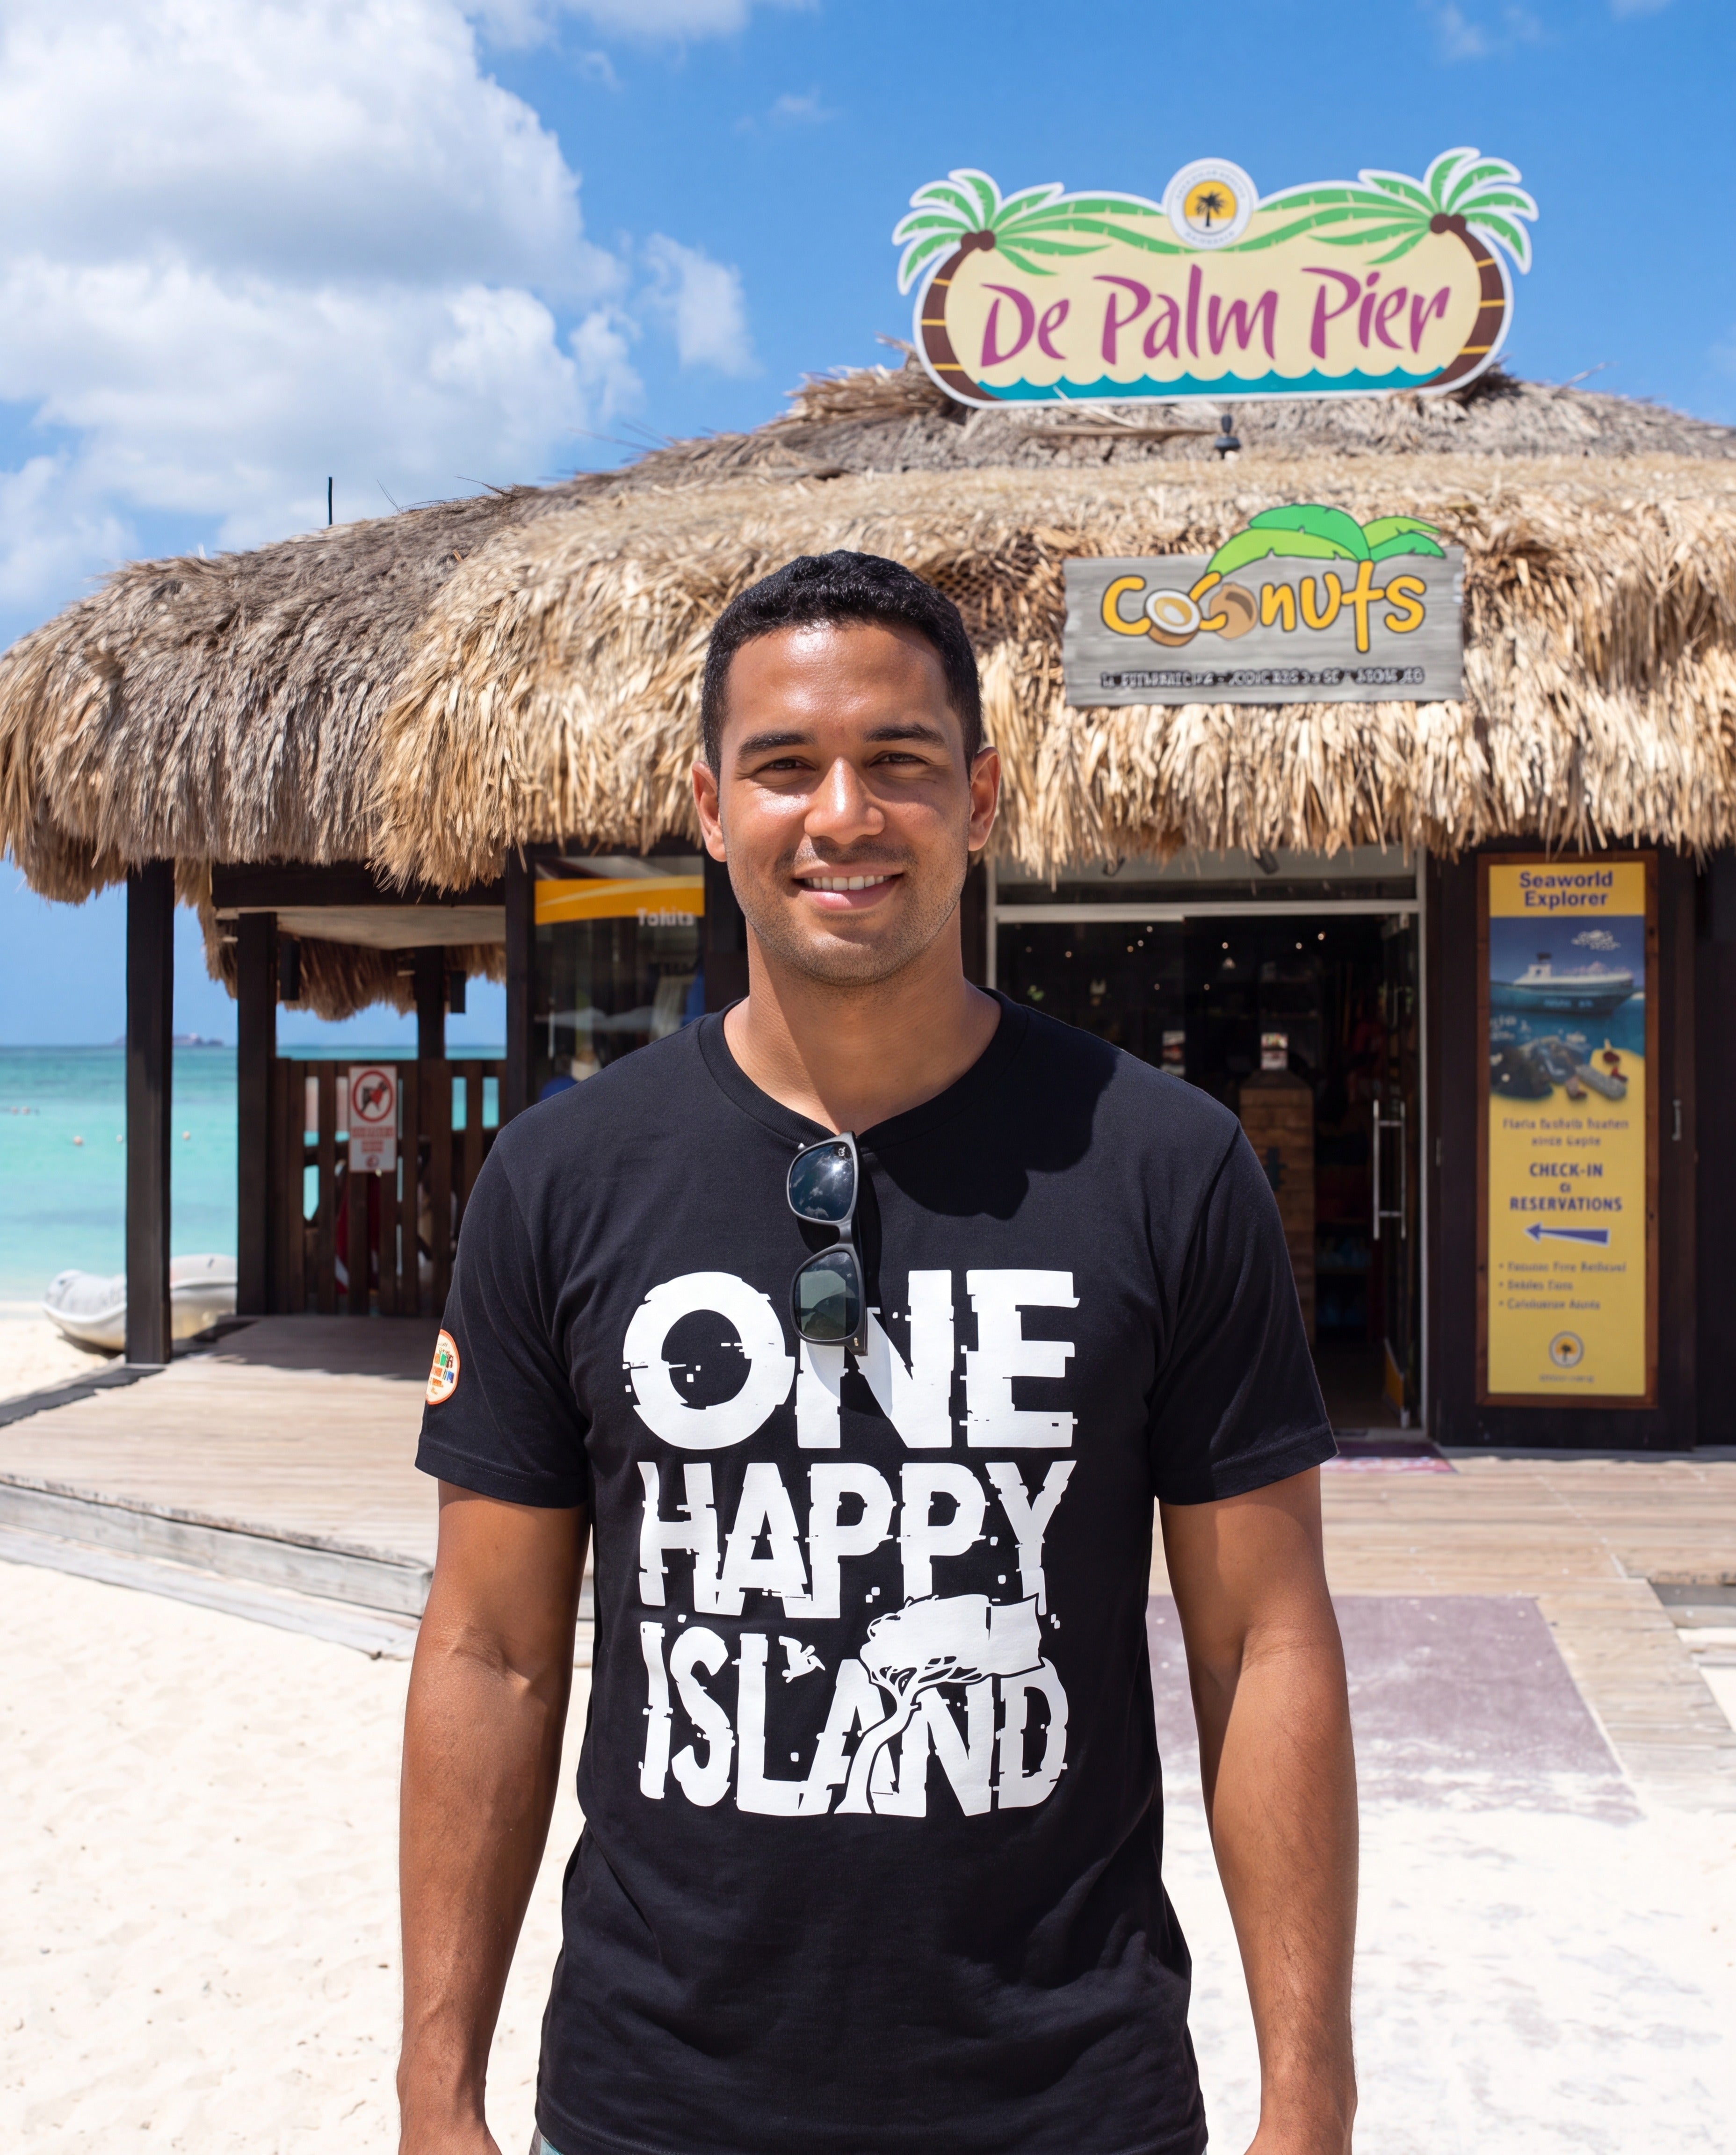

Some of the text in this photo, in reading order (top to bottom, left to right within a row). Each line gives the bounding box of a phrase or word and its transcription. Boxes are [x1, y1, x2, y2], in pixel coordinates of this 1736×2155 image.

[980, 263, 1451, 368] De Palm Pier
[1519, 871, 1613, 889] Seaworld
[1524, 890, 1608, 910] Explorer
[1529, 1163, 1603, 1177] CHECK-IN
[1509, 1196, 1622, 1212] RESERVATIONS
[622, 1269, 1078, 1450] ONE
[637, 1460, 1078, 1619] HAPPY
[638, 1620, 1070, 1817] ISLAND
